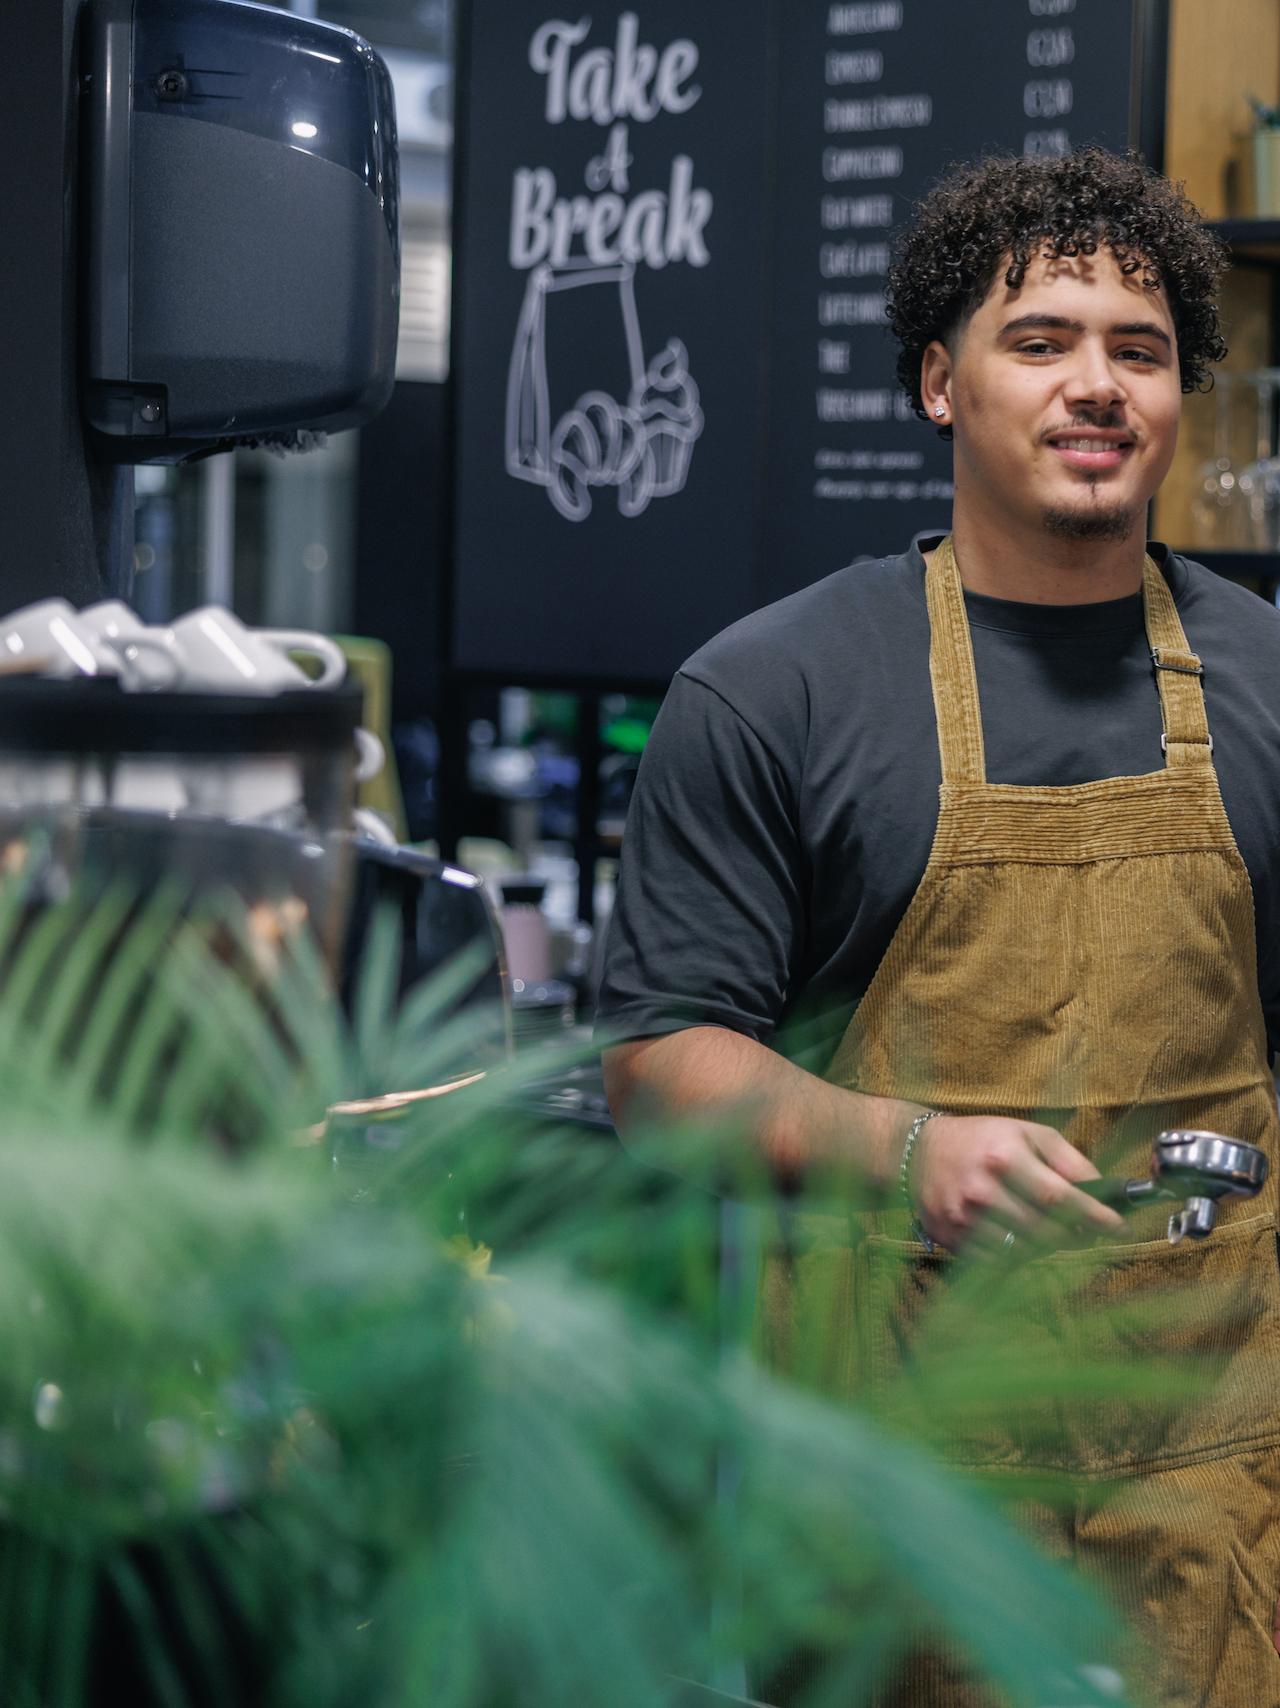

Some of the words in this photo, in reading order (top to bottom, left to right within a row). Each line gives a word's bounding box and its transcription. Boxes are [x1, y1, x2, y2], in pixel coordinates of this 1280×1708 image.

[528, 10, 703, 126] Take
[509, 154, 713, 269] Break
[585, 121, 634, 194] A
